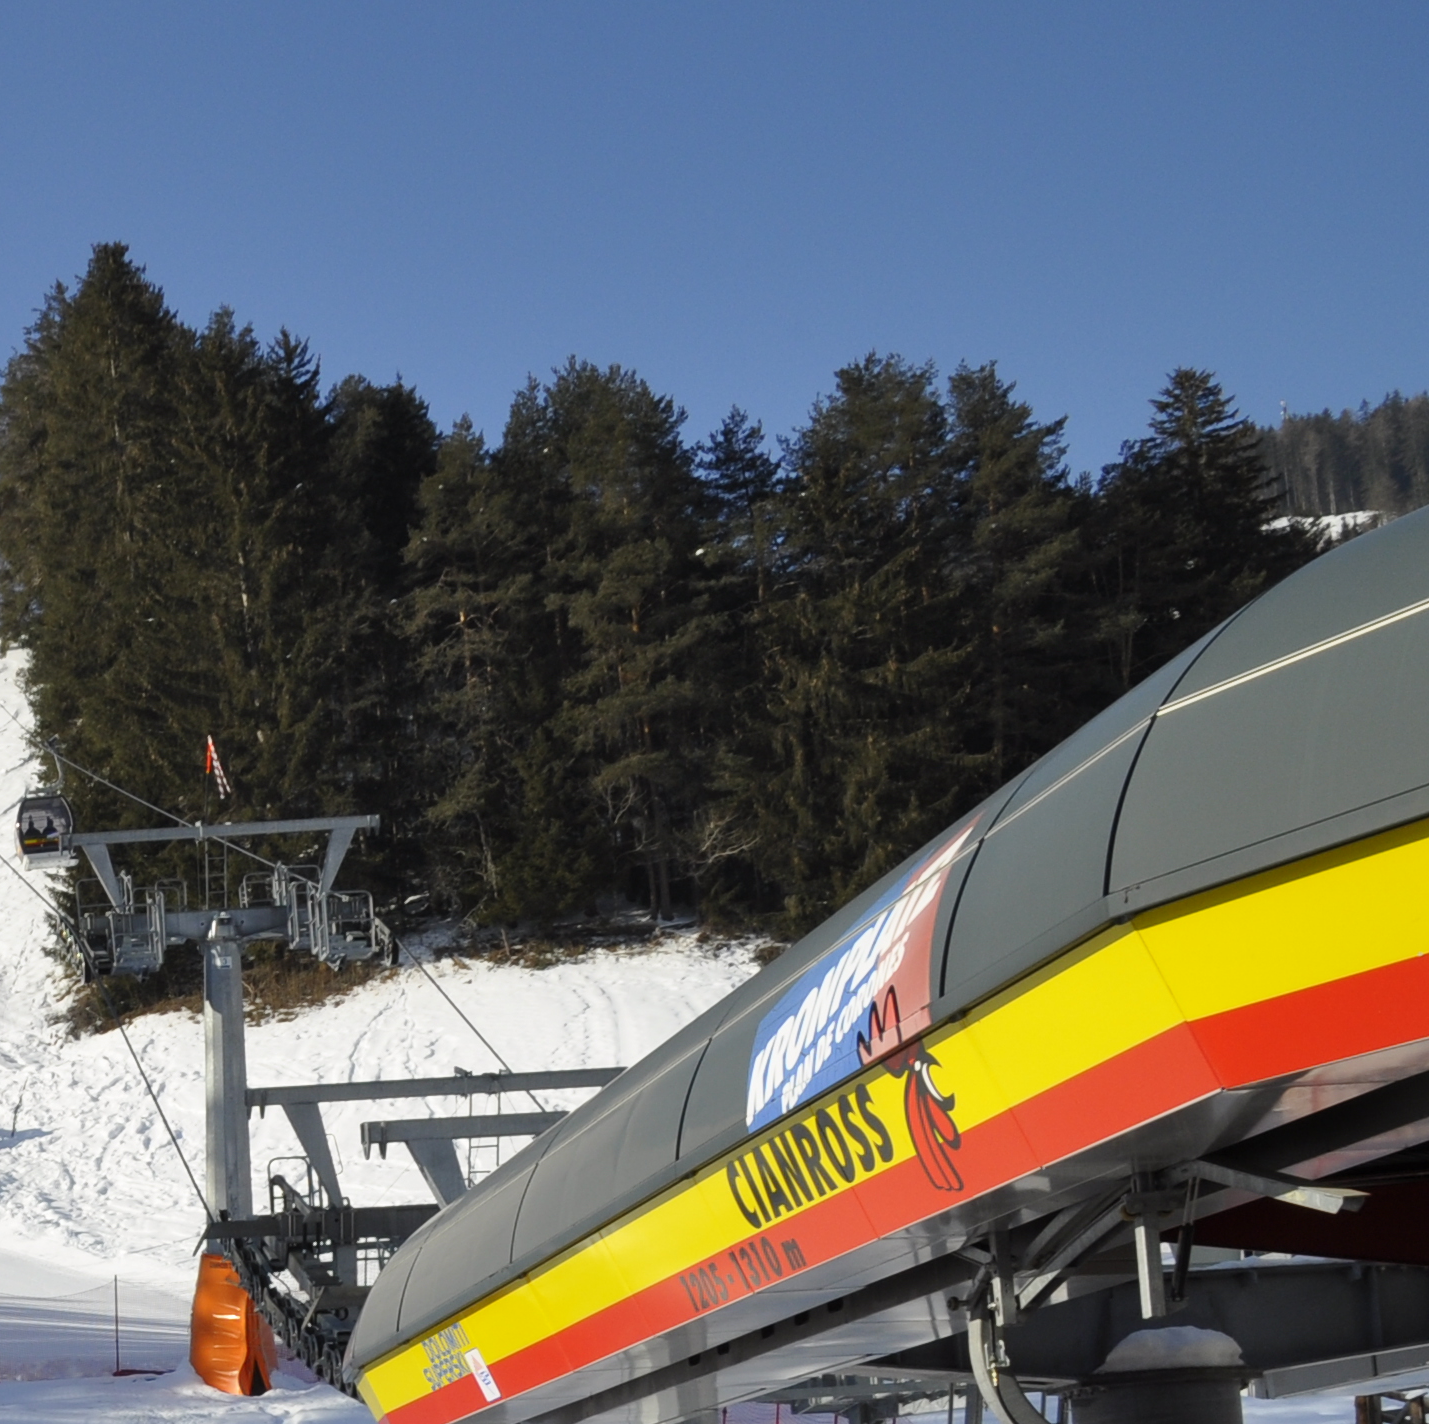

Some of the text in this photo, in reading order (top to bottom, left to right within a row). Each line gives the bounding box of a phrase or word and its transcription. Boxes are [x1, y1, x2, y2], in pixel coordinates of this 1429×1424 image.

[746, 826, 974, 1127] KRONPLATZ
[781, 932, 911, 1115] PLAN DE CORONES
[726, 1083, 894, 1229] CIANROSS
[421, 1322, 471, 1363] DOLOMITI
